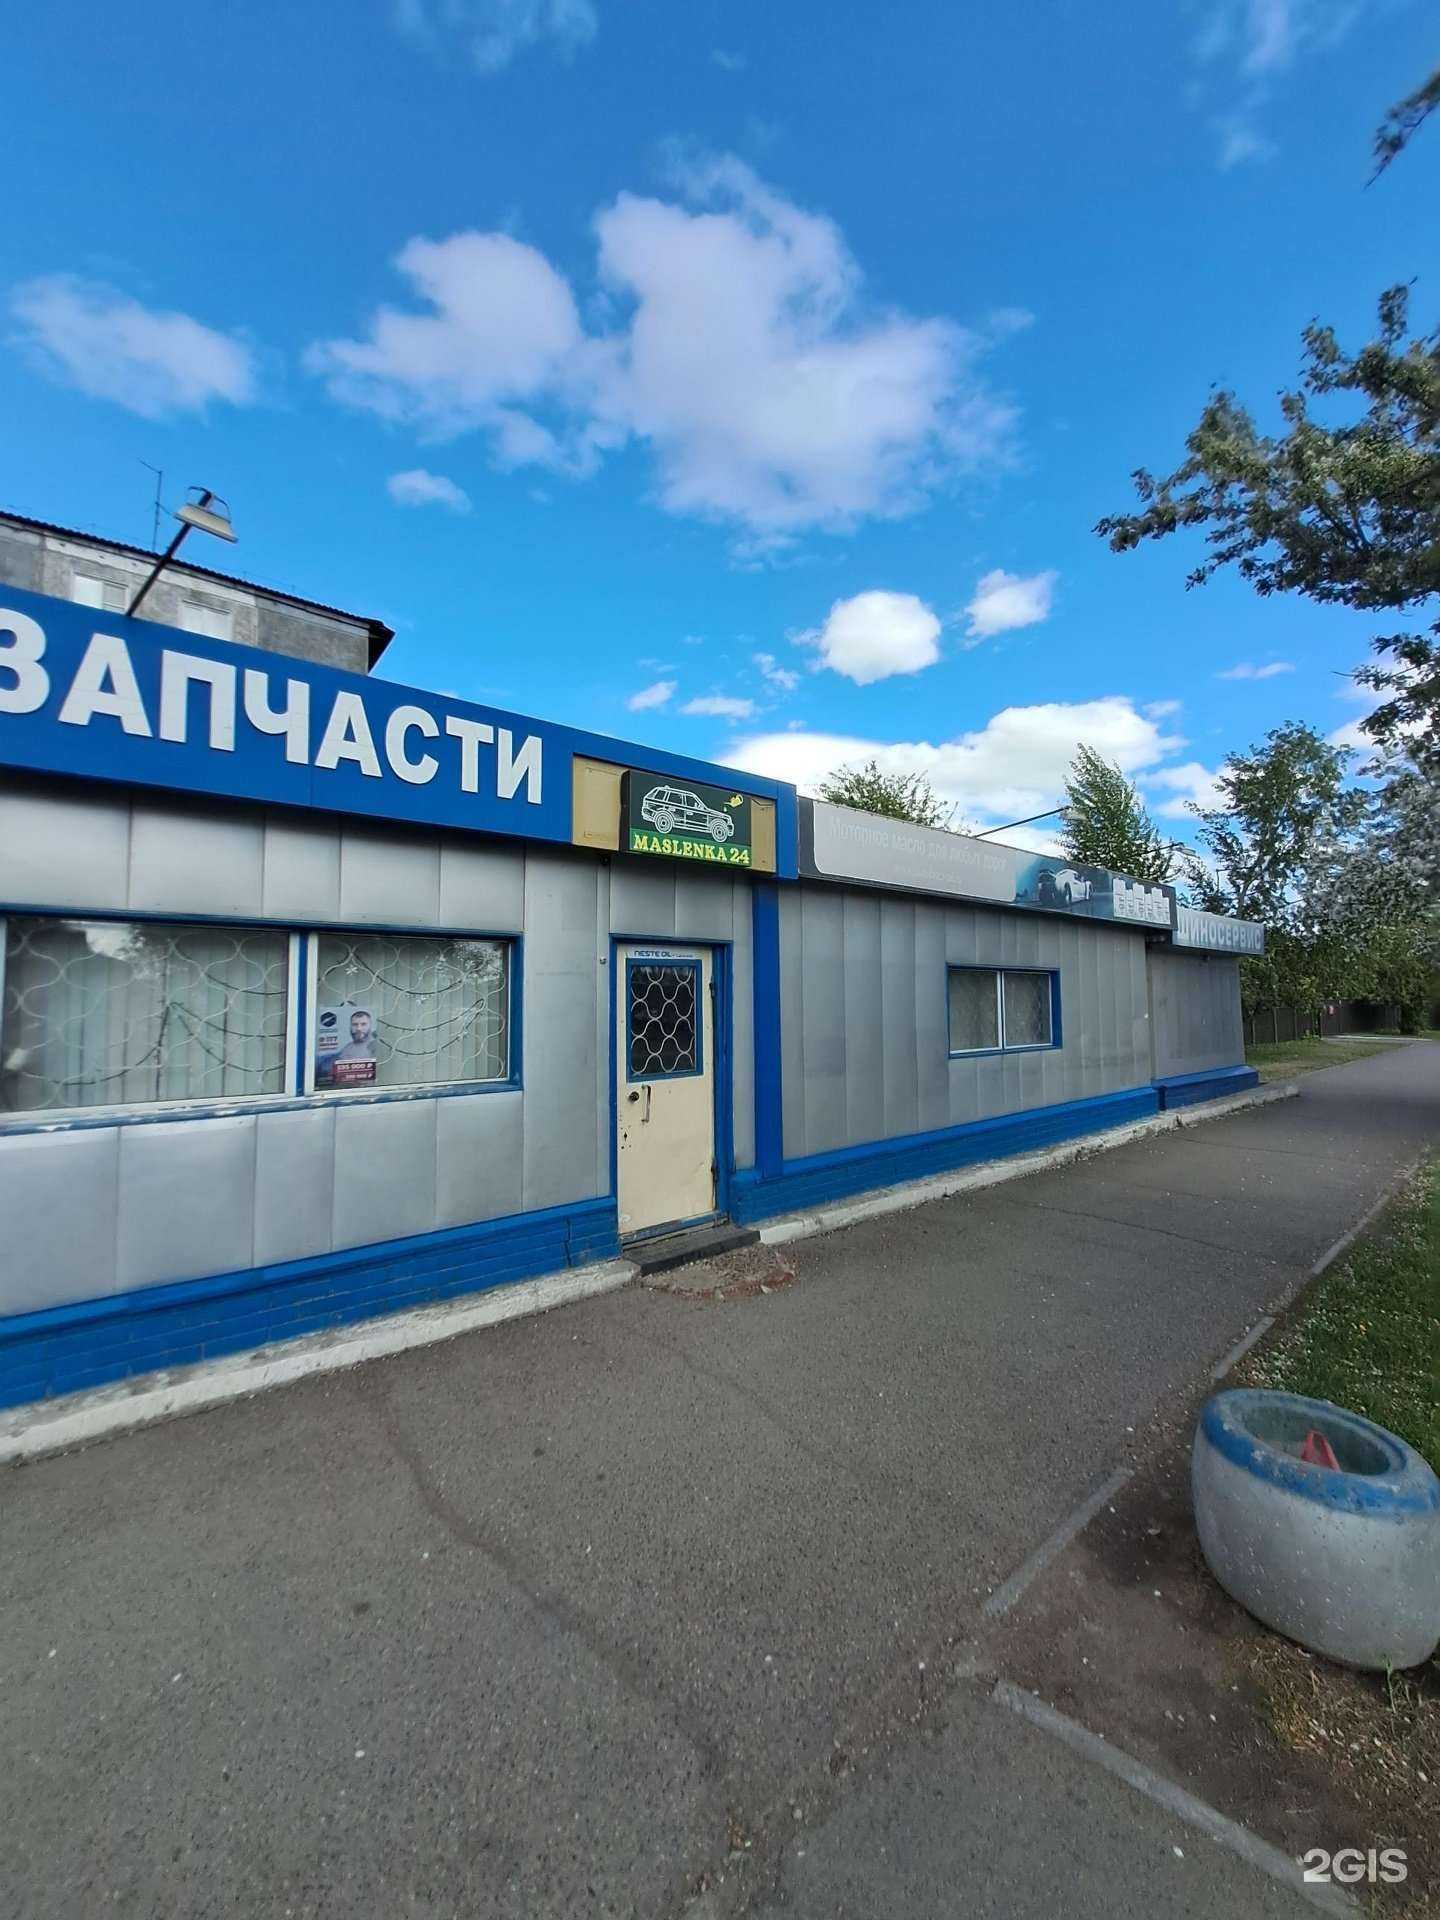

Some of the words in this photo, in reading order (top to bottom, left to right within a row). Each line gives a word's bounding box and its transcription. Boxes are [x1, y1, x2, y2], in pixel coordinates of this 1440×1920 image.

[0, 607, 543, 805] ЗАПЧАСТИ
[633, 834, 727, 862] MASLENKA
[730, 848, 750, 864] 24
[1177, 911, 1261, 950] ШИНОСЕРВИС
